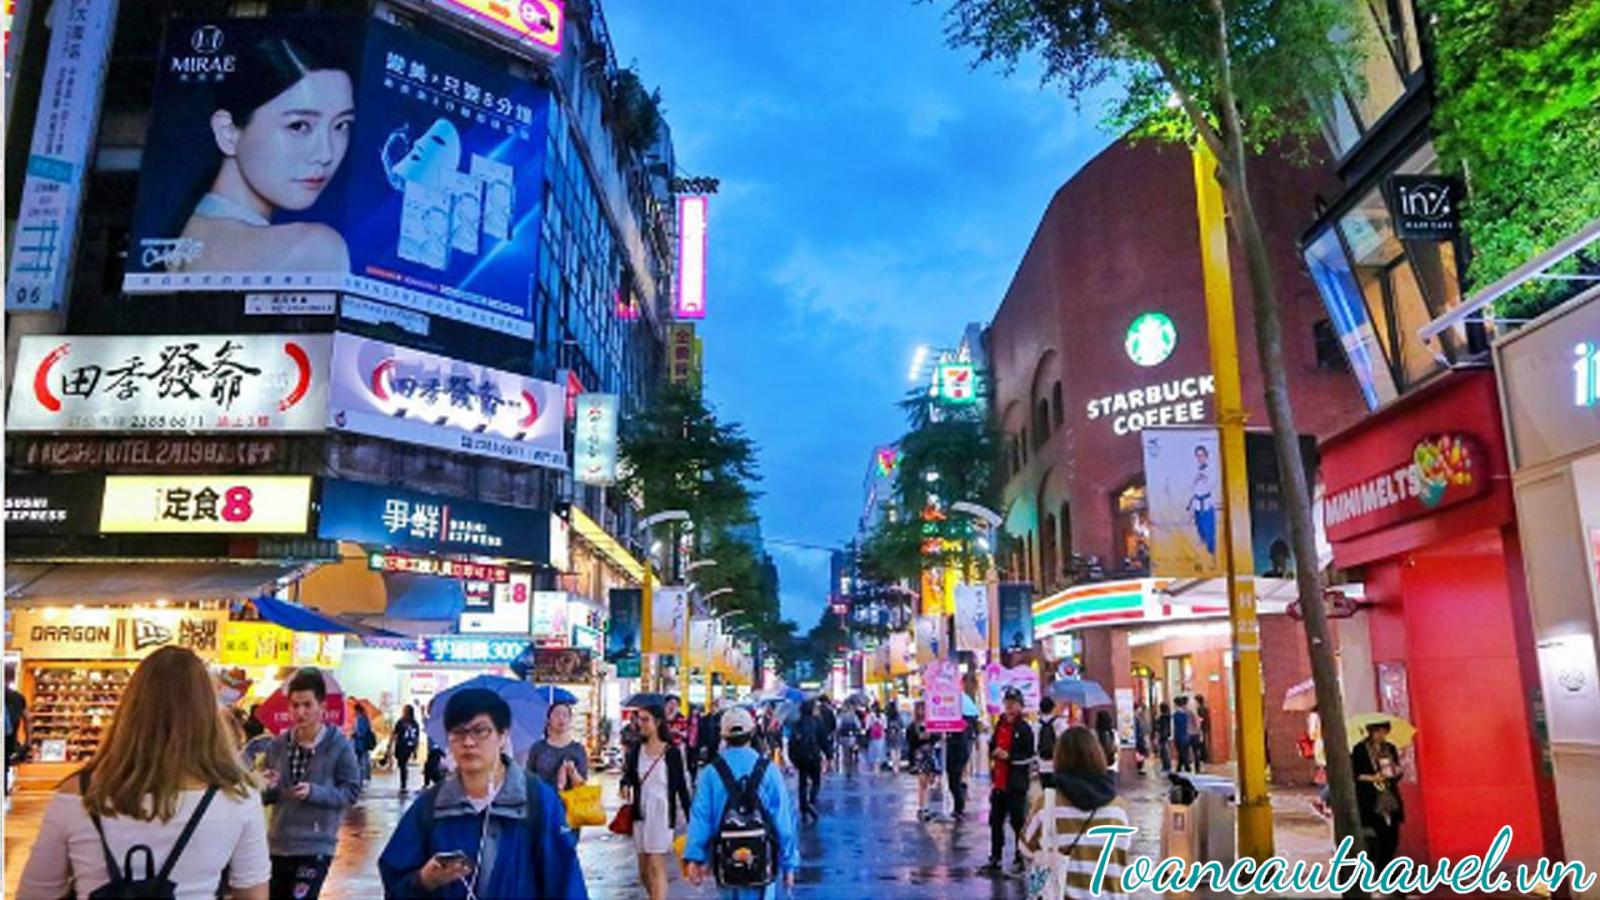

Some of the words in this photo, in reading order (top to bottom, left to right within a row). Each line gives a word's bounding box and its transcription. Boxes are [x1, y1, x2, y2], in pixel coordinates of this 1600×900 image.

[170, 55, 236, 73] MIRAE
[1087, 374, 1215, 419] STARBUCK
[1113, 399, 1205, 435] COFFEE
[1324, 463, 1421, 527] MINIMELTS
[381, 498, 440, 539] 爭鮮
[449, 532, 503, 547] EXPRESS
[30, 625, 111, 642] DRAGON
